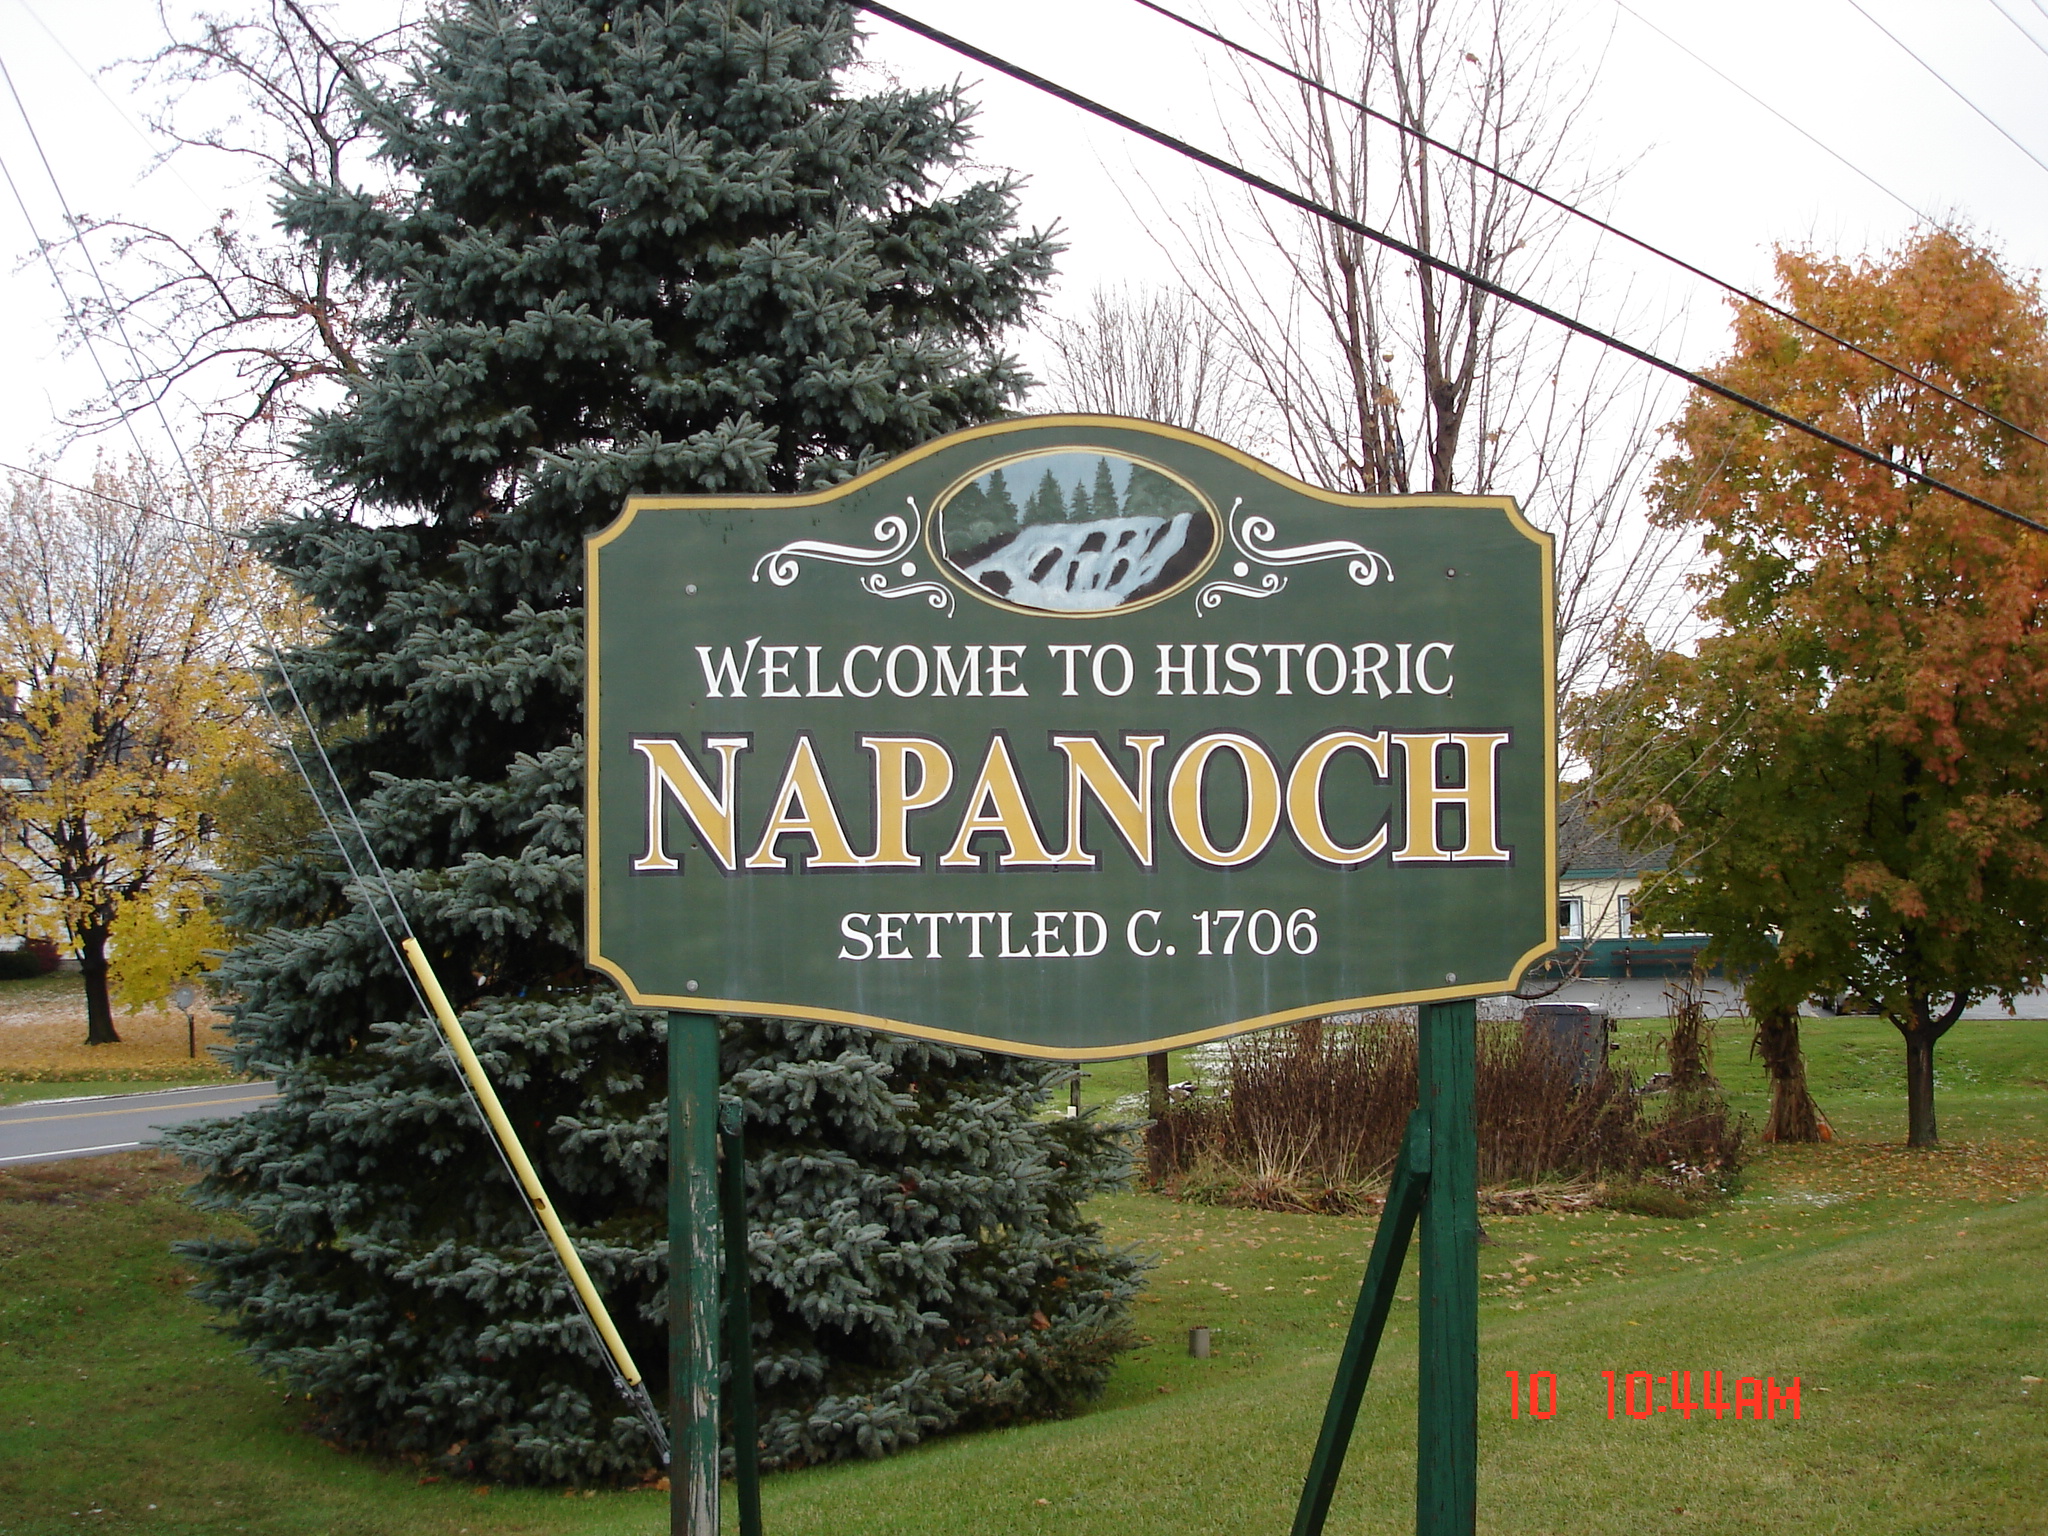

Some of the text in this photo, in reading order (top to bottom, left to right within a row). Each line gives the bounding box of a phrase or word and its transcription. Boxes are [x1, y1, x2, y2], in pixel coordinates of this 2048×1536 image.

[694, 635, 1455, 700] WELCOME TO HISTORIC
[631, 731, 1511, 872] NAPANOCH
[837, 908, 1319, 961] SETTLED C. 1706
